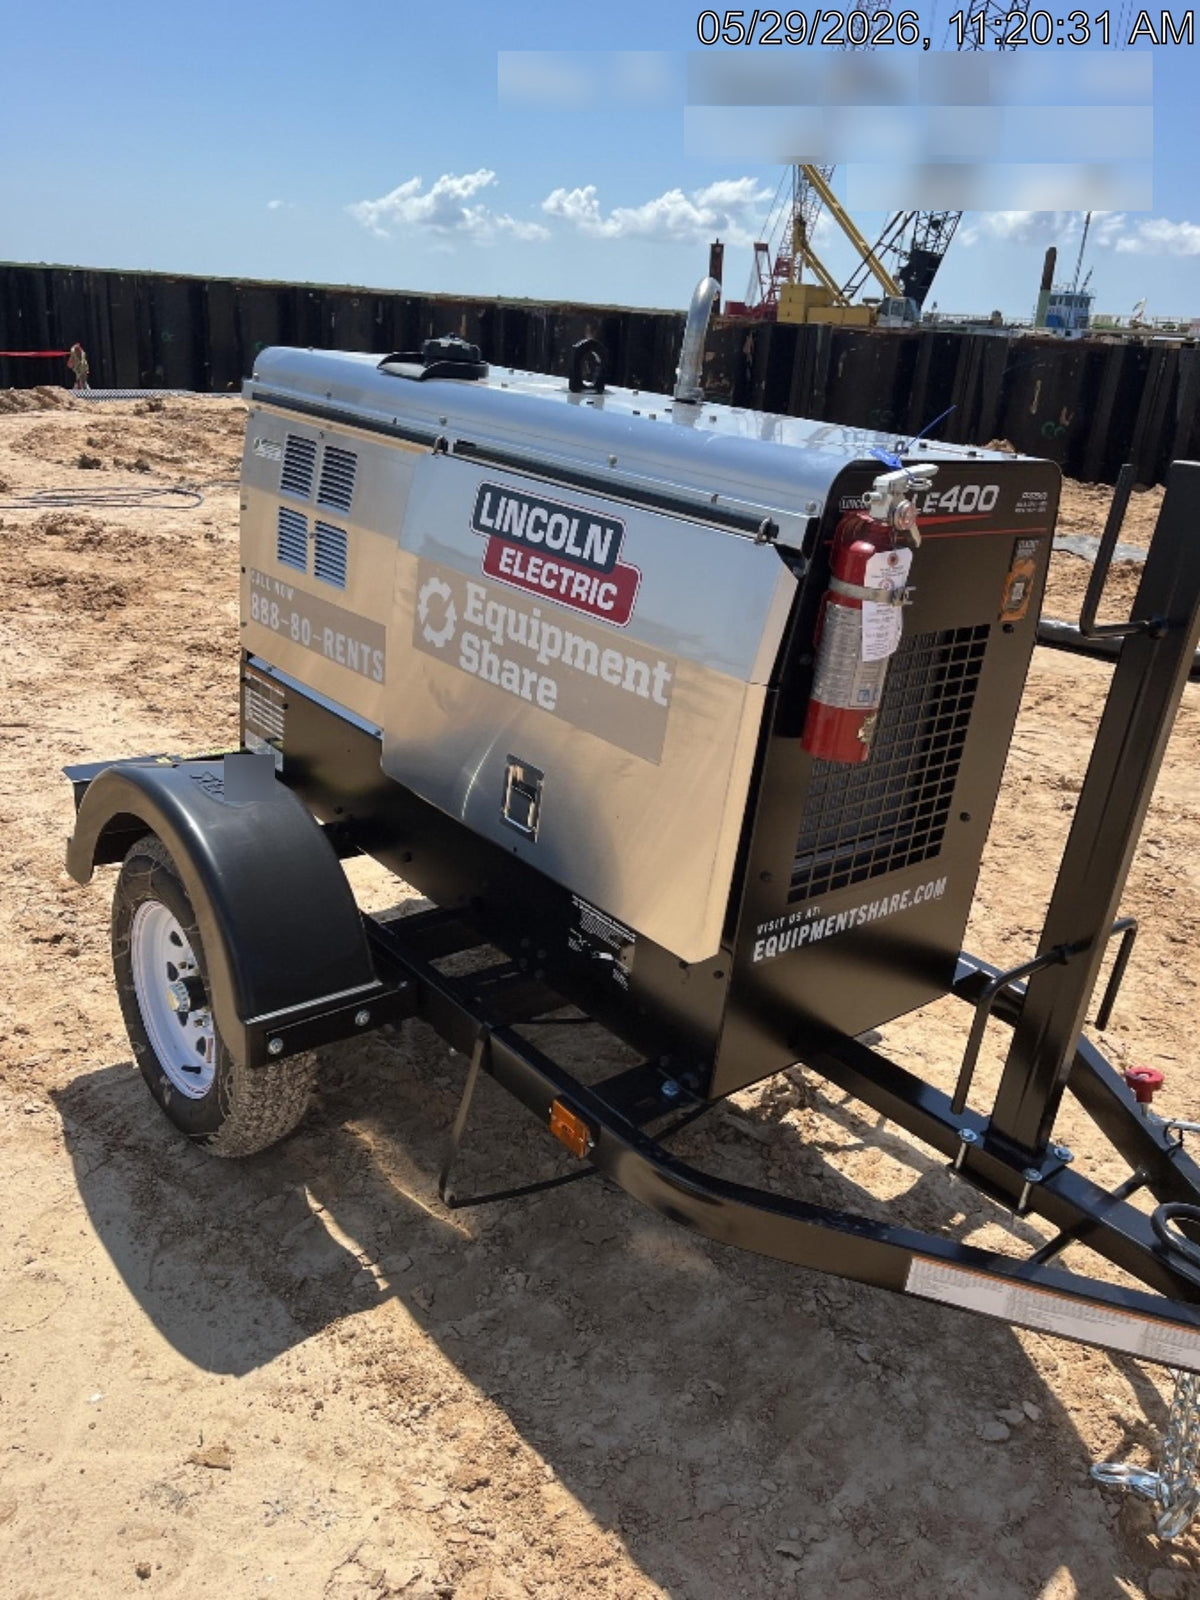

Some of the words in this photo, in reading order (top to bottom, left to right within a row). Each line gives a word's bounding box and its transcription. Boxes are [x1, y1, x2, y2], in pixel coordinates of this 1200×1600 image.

[480, 492, 613, 566] LINCOLN
[499, 547, 618, 611] ELECTRIC
[251, 592, 383, 681] 888-80-RENTS
[459, 631, 558, 712] Share
[463, 581, 673, 707] Equipment
[753, 876, 948, 962] EQUIPMENTSHARE.COM
[757, 916, 786, 935] VISIT
[789, 911, 802, 925] US
